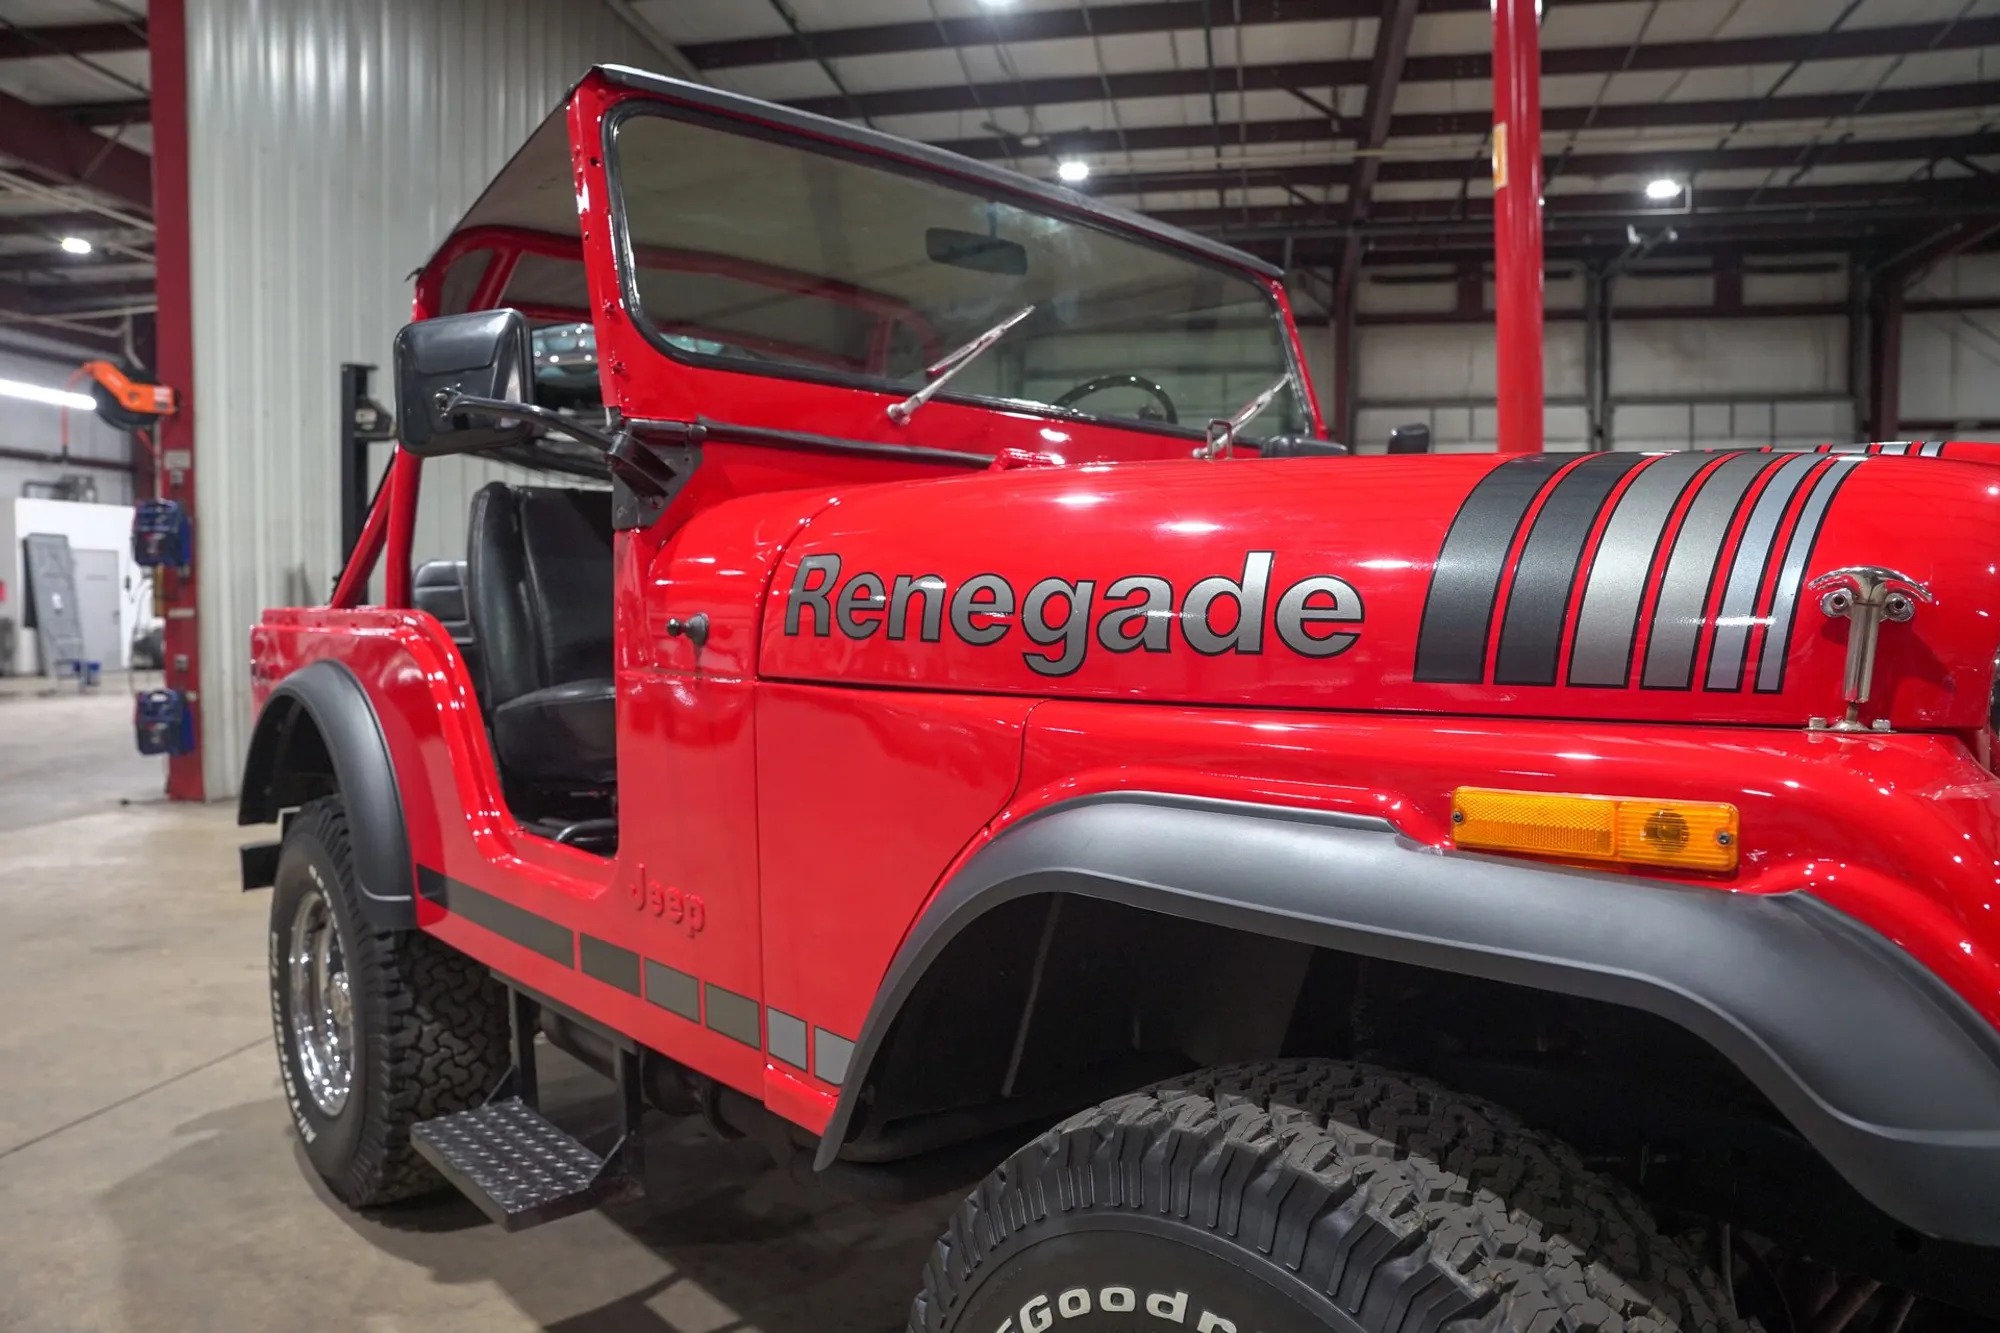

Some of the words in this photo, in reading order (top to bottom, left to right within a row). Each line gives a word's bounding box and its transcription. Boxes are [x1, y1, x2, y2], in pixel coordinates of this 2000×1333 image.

[783, 550, 1366, 678] Renegade
[628, 862, 706, 939] Jeep
[995, 1286, 1238, 1333] Goodr
